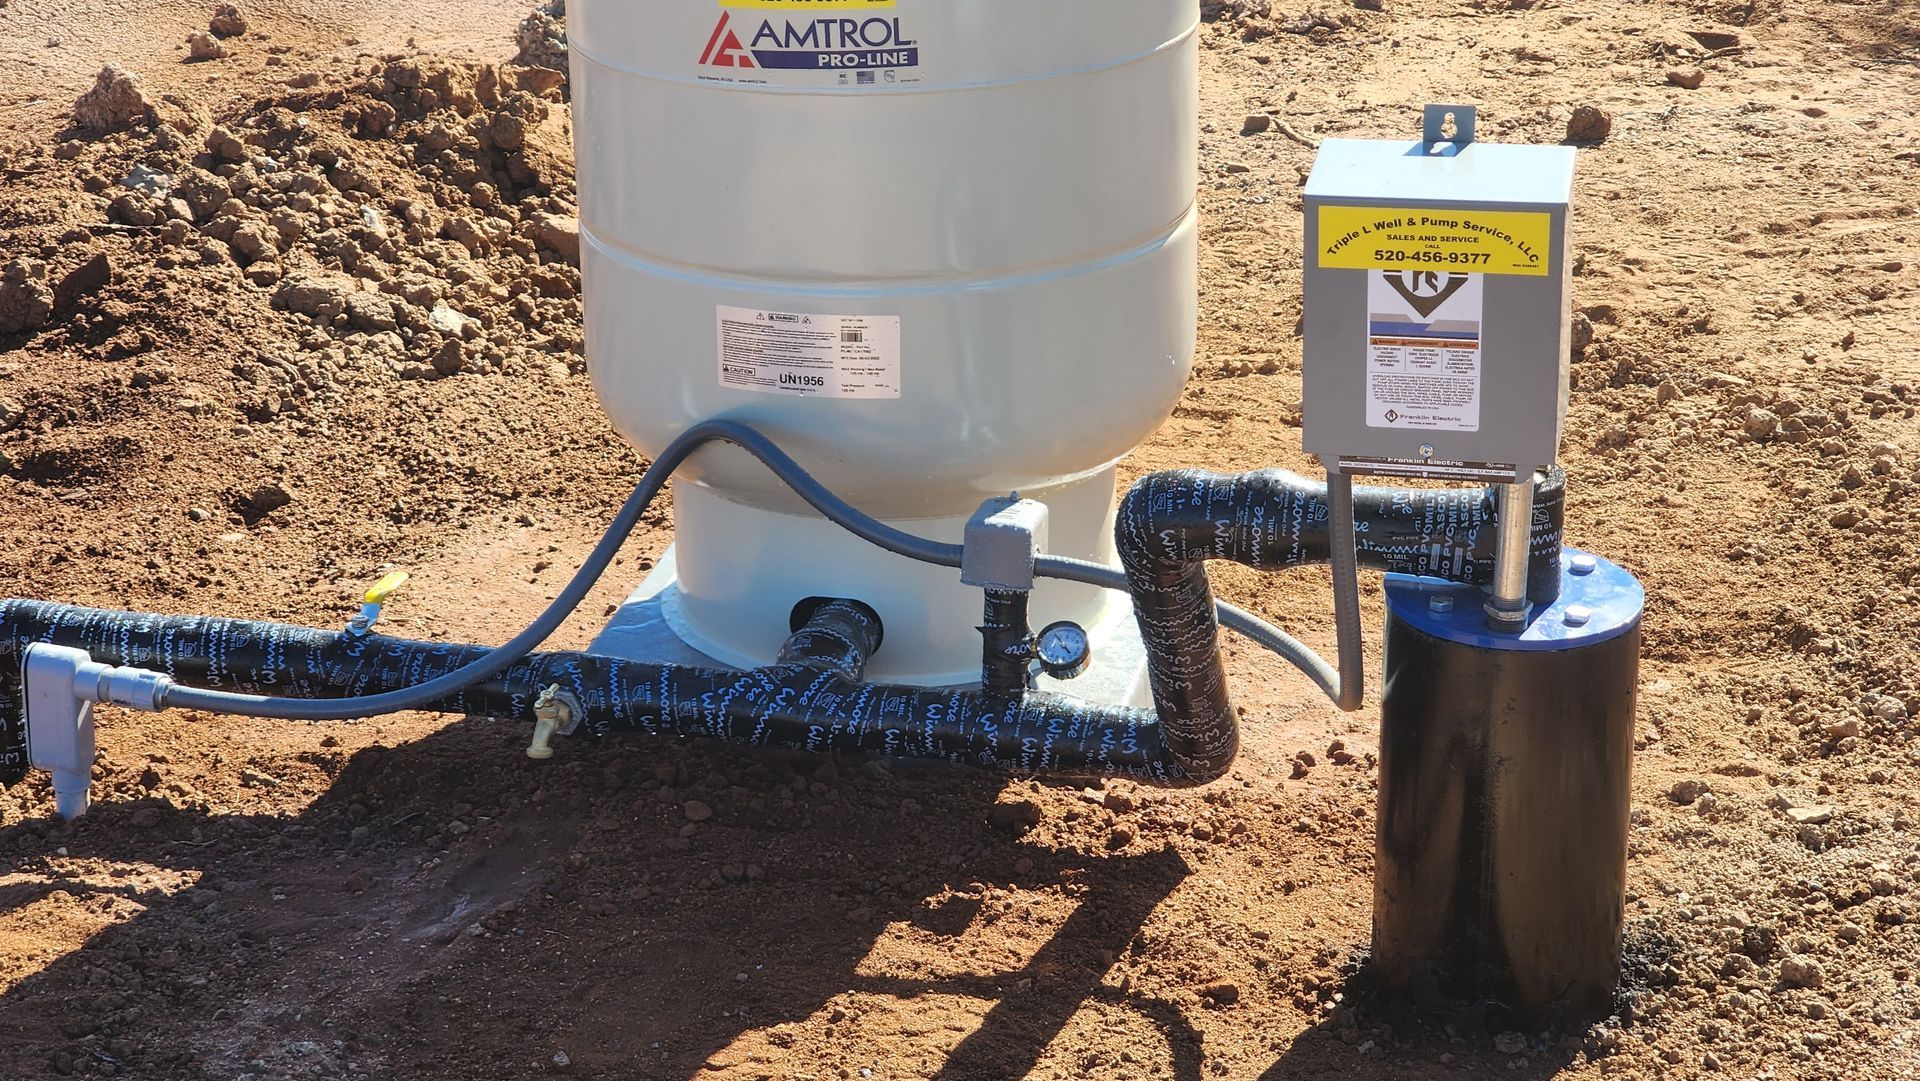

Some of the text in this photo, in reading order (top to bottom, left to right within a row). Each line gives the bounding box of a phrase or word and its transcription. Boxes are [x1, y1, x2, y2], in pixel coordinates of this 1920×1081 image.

[750, 17, 912, 48] AMTROL
[818, 52, 908, 67] PRO-LINE
[1327, 217, 1539, 263] Triple L Well & Pump Service, LLC
[1374, 250, 1491, 264] 520-456-9377
[779, 373, 824, 386] UN1956
[1307, 513, 1314, 523] 10
